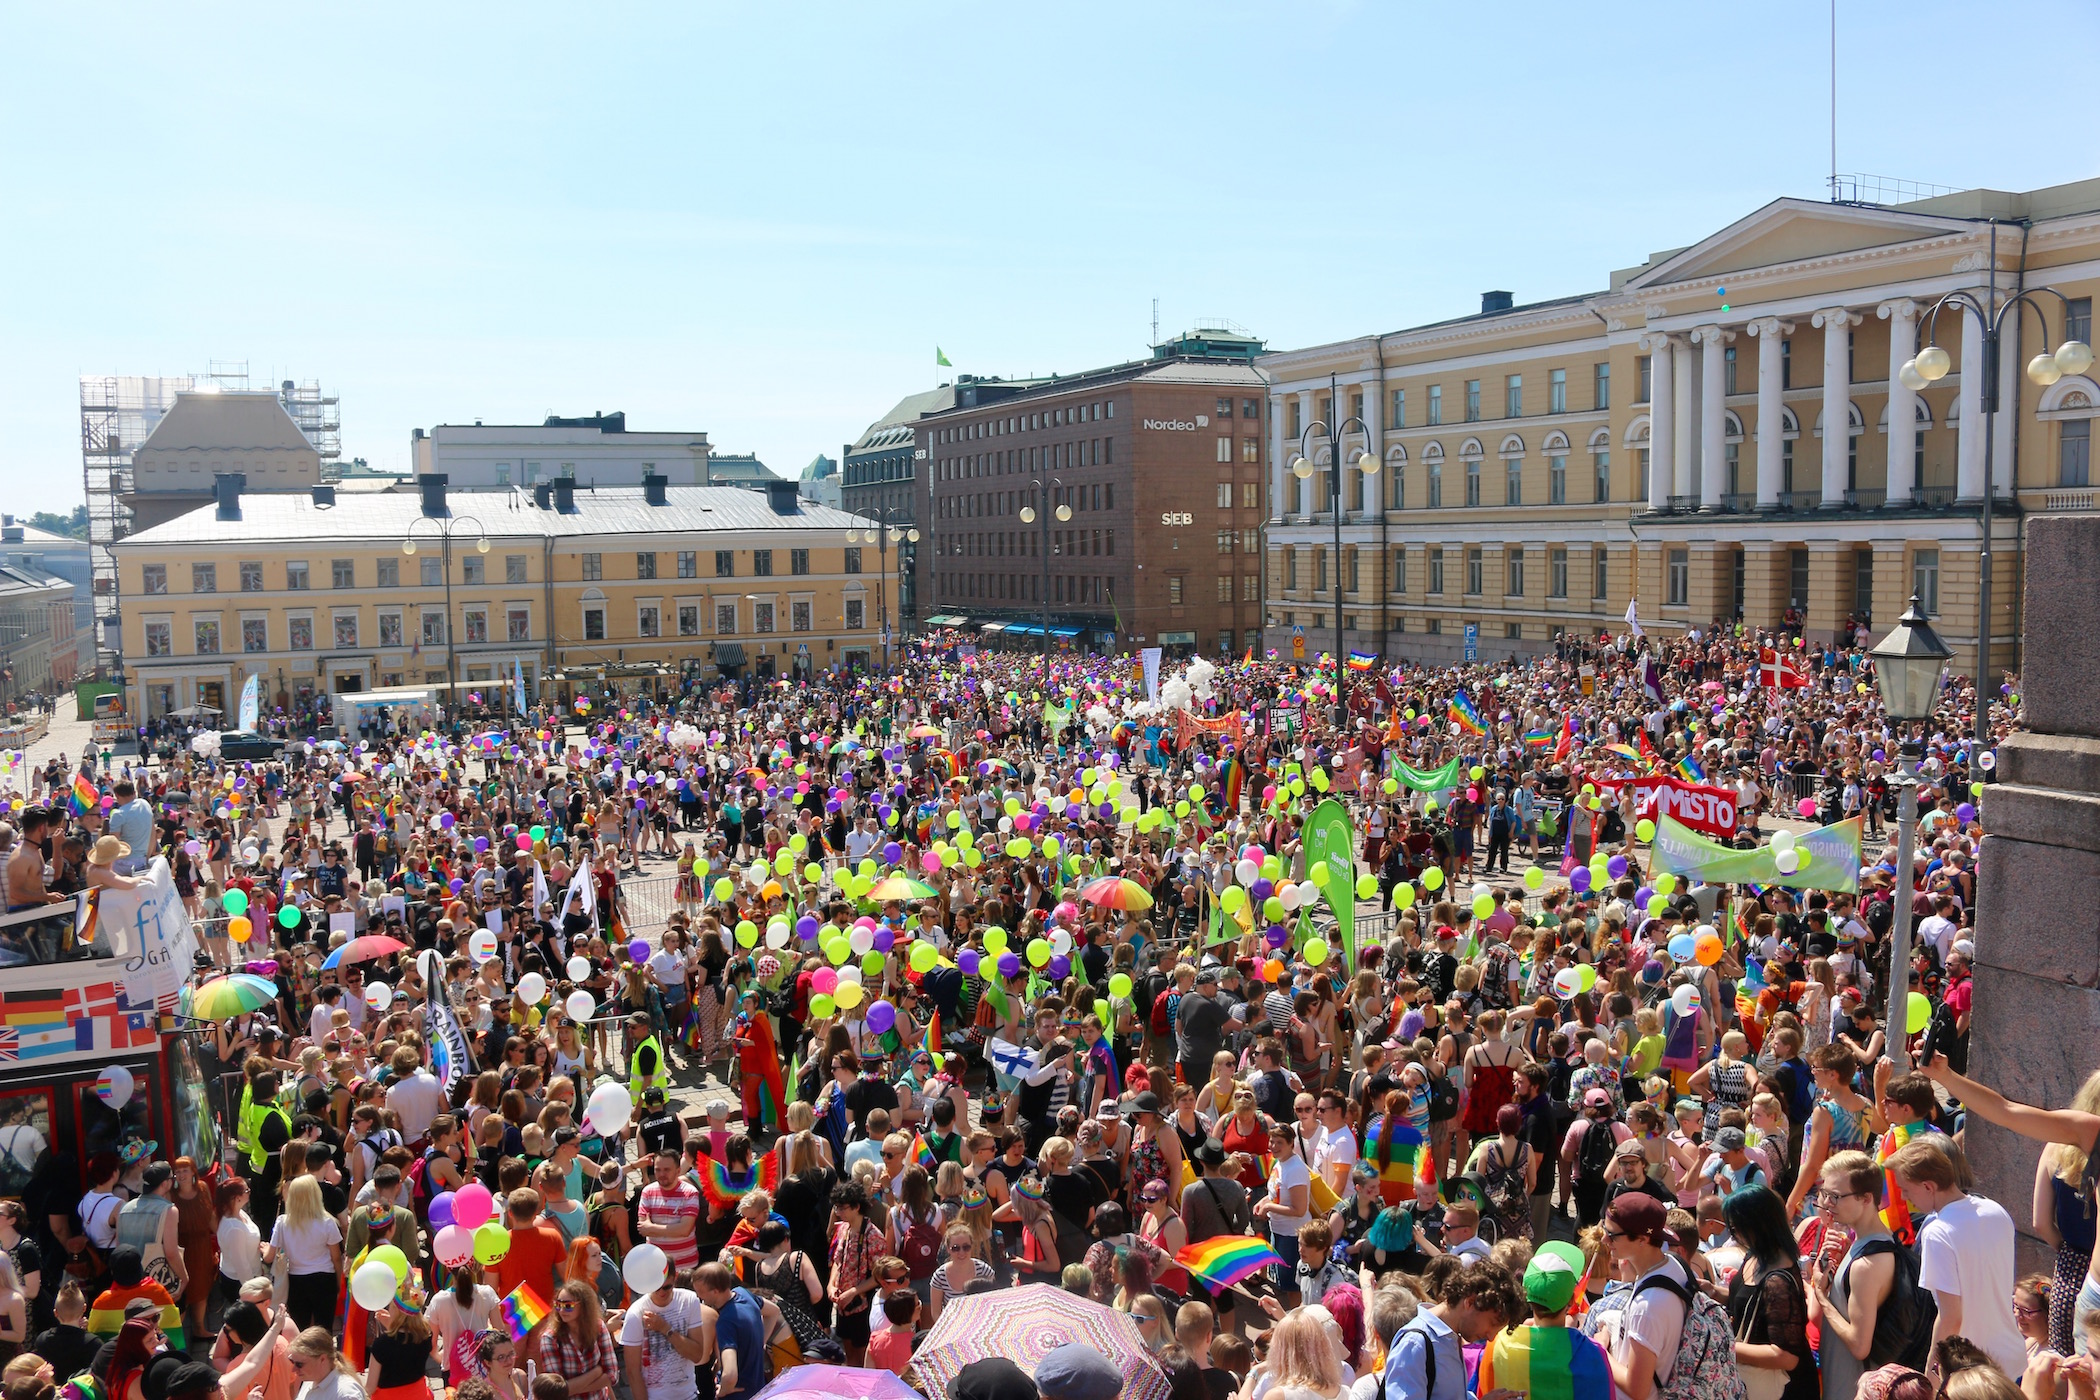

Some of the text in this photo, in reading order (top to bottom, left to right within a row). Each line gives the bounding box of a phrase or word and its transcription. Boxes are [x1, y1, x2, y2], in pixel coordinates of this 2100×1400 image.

[1143, 419, 1195, 431] Nordea
[915, 449, 926, 460] SEB
[1161, 511, 1193, 527] SEB
[1466, 626, 1475, 637] P
[657, 1134, 665, 1150] 7
[444, 1252, 467, 1266] SAK
